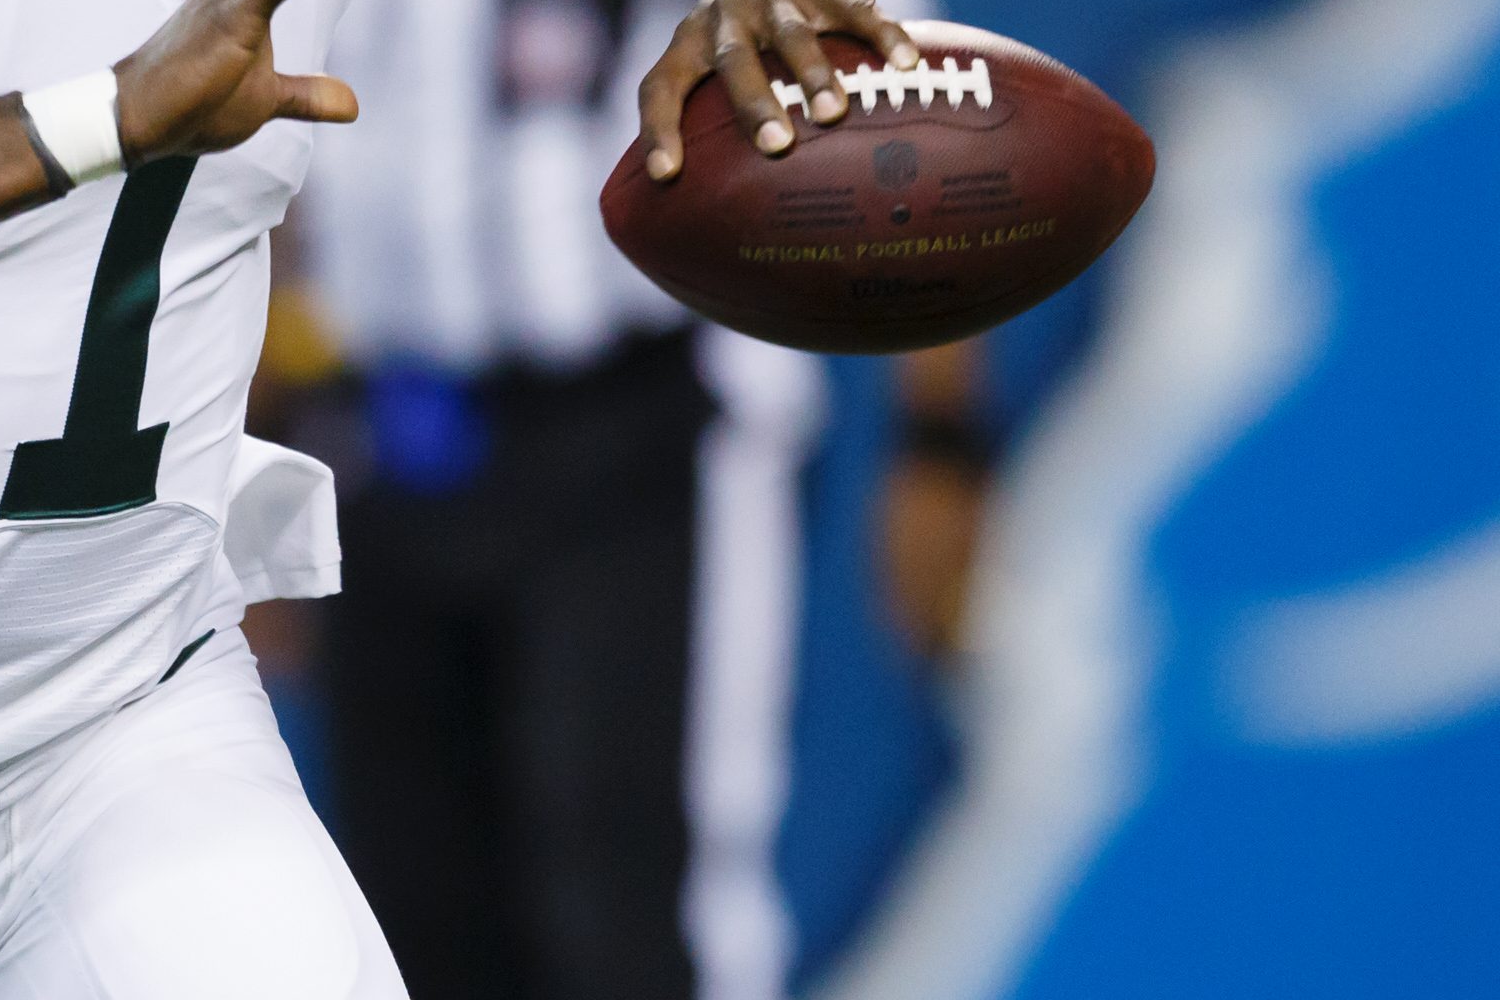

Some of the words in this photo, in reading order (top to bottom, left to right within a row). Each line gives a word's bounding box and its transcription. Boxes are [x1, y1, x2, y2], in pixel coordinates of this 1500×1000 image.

[739, 244, 845, 263] NATIONAL
[855, 231, 972, 261] FOOTBALL
[980, 217, 1057, 248] LEAGUE
